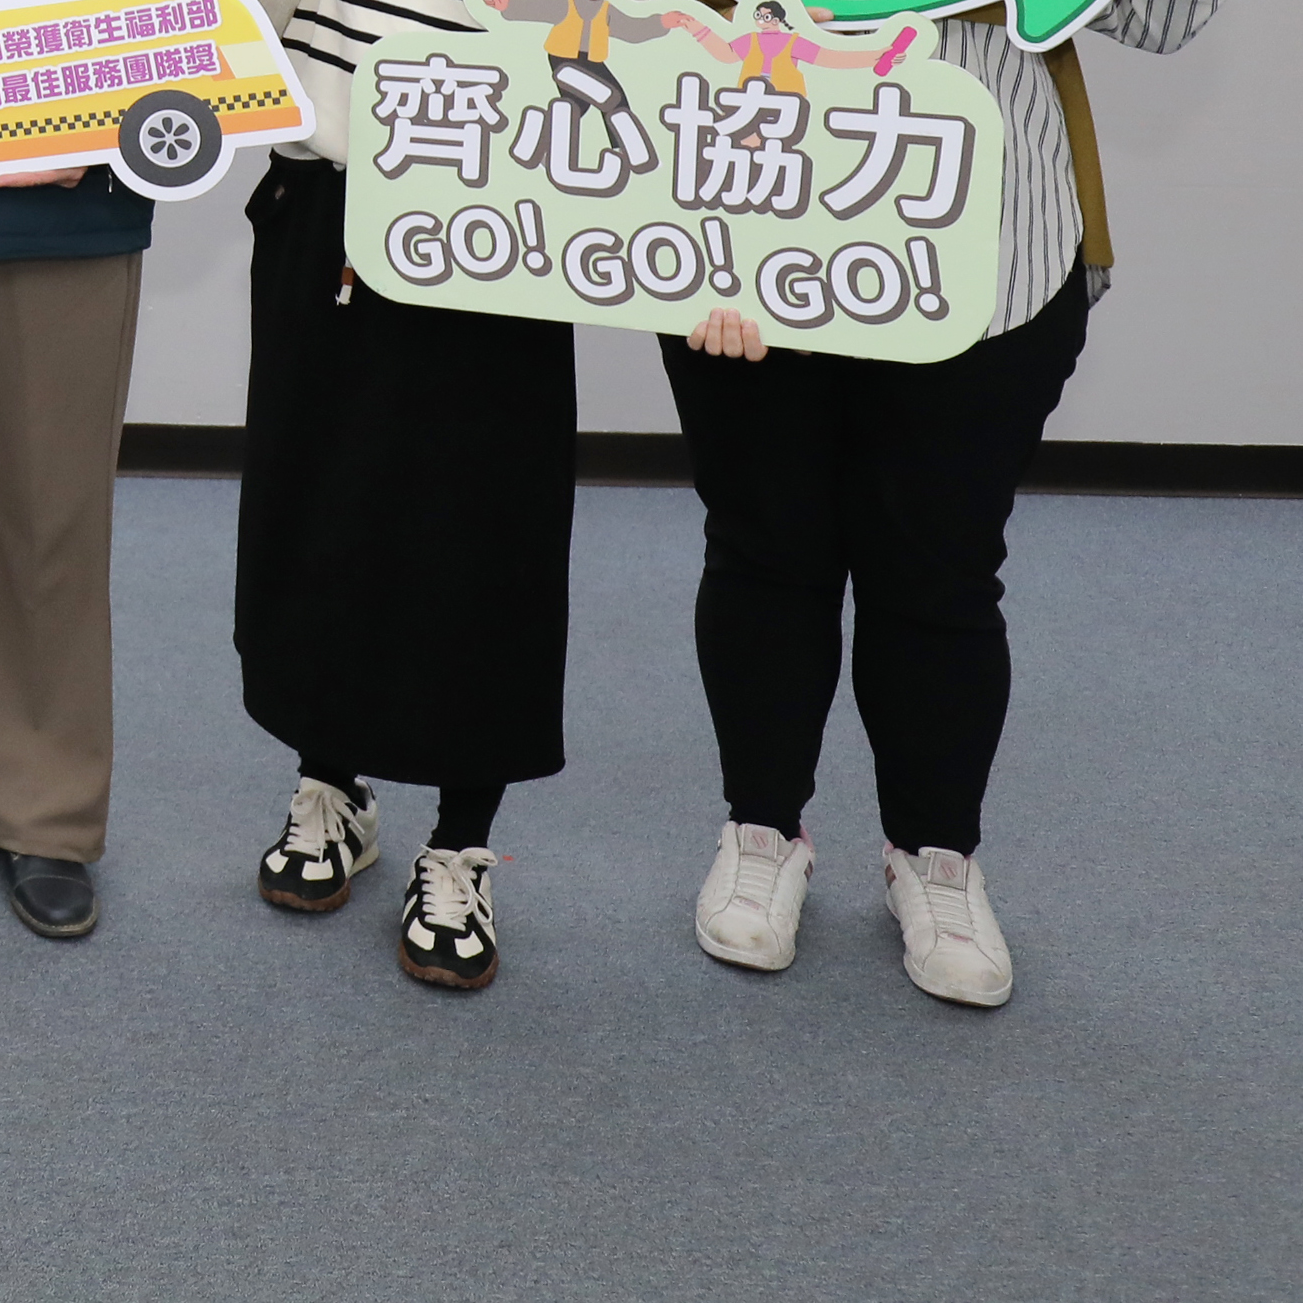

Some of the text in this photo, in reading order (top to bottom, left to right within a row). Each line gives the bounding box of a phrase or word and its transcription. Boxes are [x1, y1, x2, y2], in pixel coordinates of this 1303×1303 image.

[374, 54, 975, 227] 齊心協力
[385, 199, 949, 329] GO! GO! GO!
